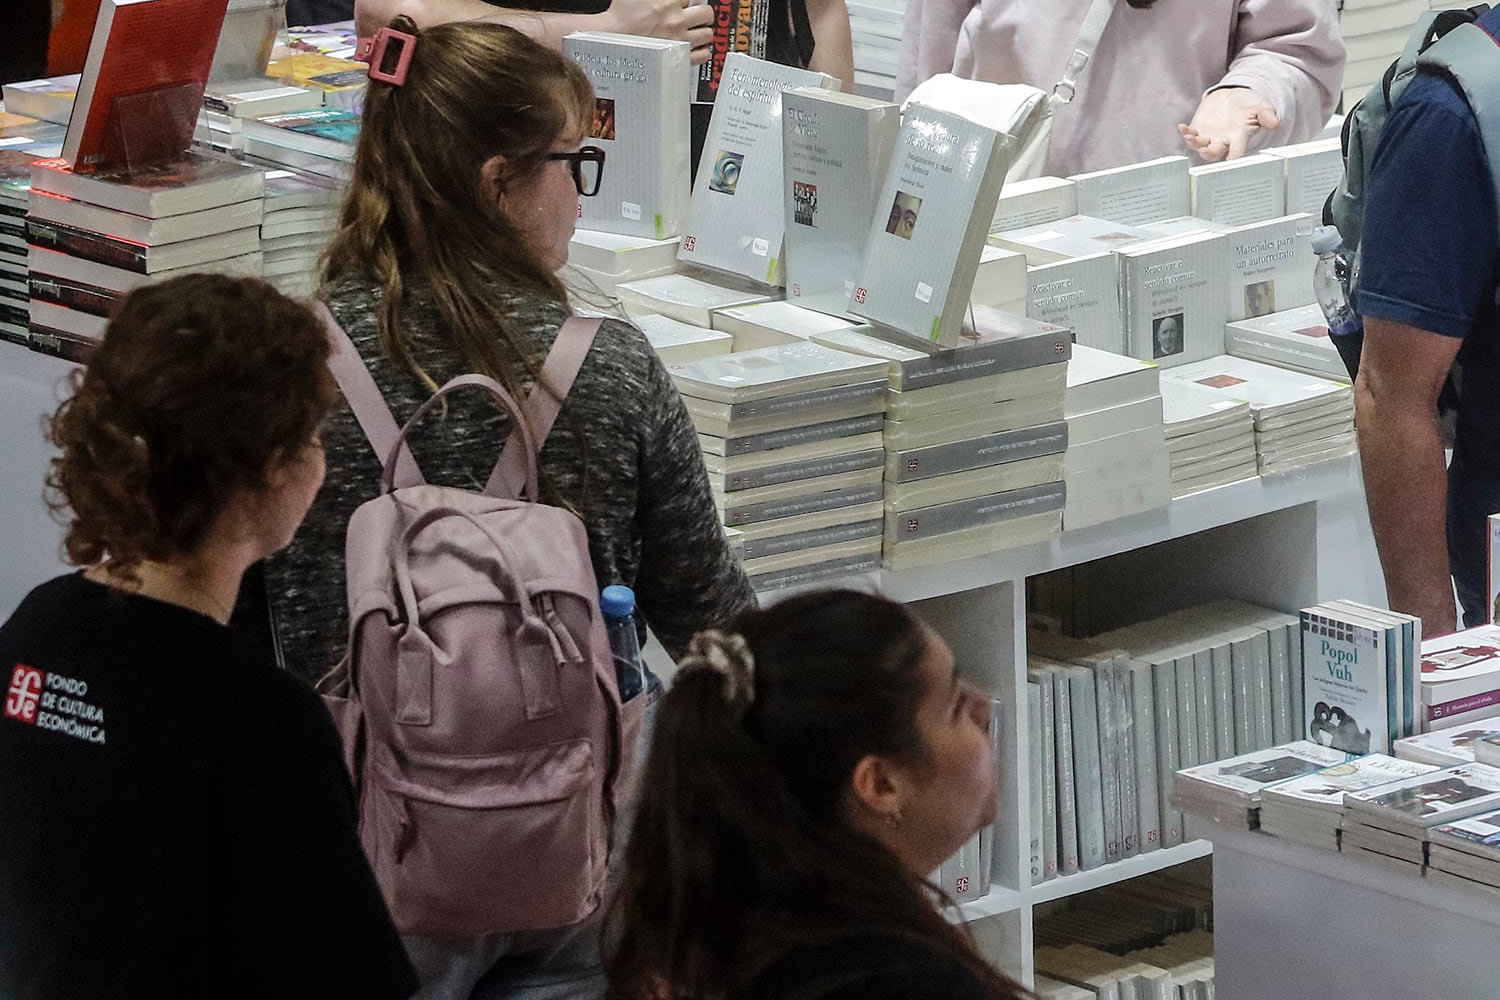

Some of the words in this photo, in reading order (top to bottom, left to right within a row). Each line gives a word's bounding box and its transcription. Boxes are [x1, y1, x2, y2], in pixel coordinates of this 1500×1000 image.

[1277, 237, 1294, 249] para
[1235, 260, 1247, 269] un
[1321, 640, 1358, 665] Popol
[1326, 660, 1353, 682] Vuh
[46, 672, 88, 697] FONDO
[41, 692, 58, 709] DE
[57, 696, 104, 723] CULTURA
[36, 711, 105, 744] ECONÓMICA
